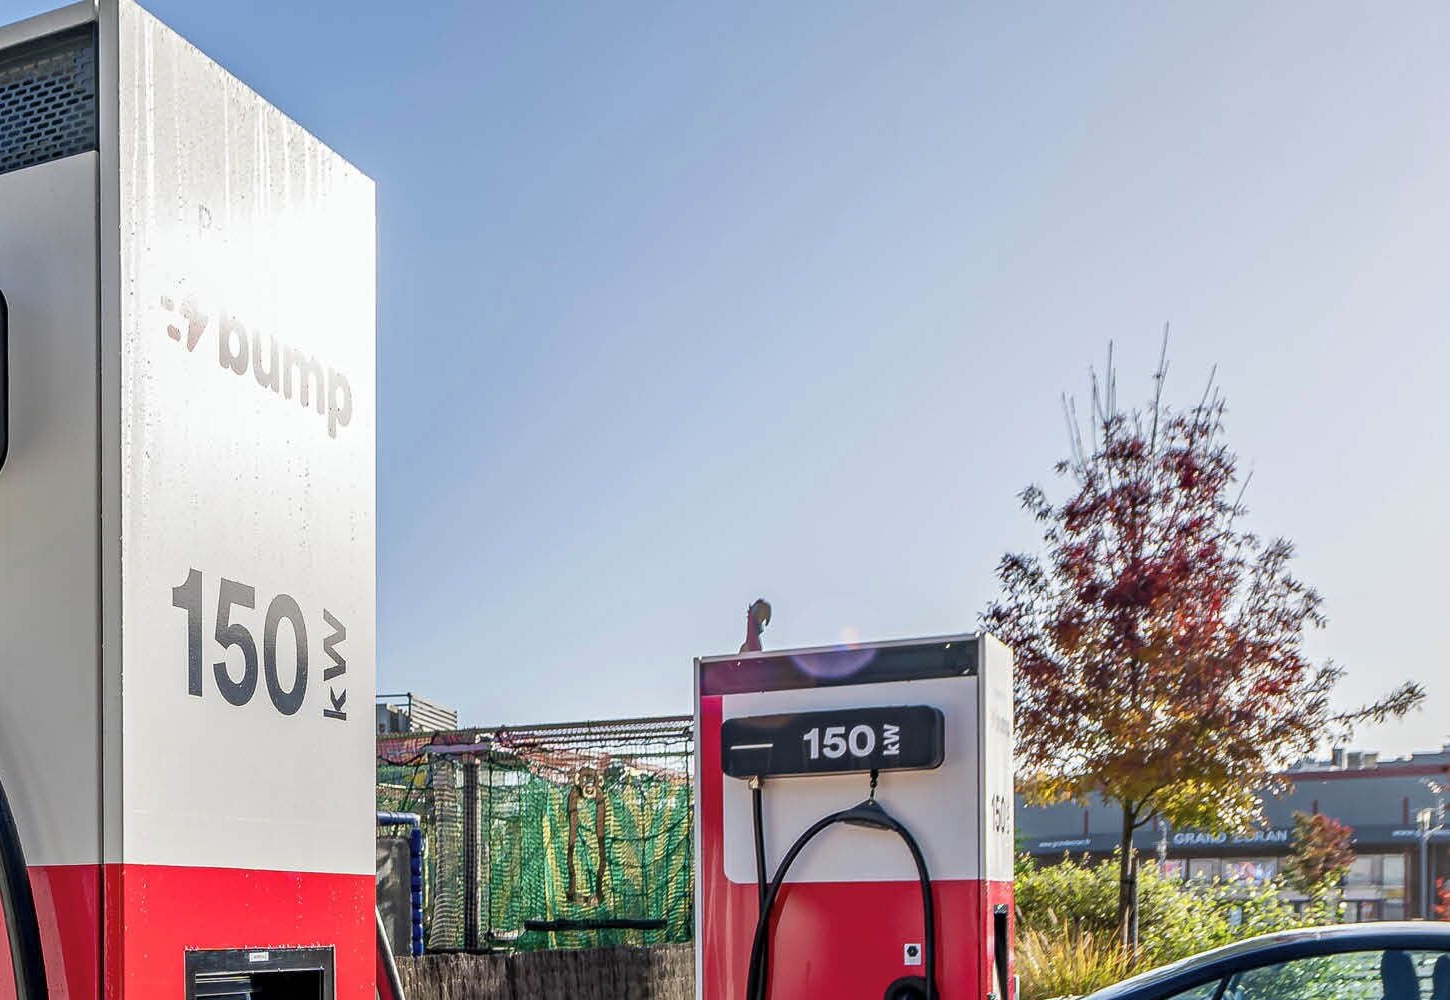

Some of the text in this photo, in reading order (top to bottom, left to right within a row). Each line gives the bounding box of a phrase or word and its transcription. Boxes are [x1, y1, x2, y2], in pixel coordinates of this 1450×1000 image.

[218, 308, 353, 439] bump
[172, 567, 347, 721] 150 kW
[802, 723, 900, 759] 150 kW
